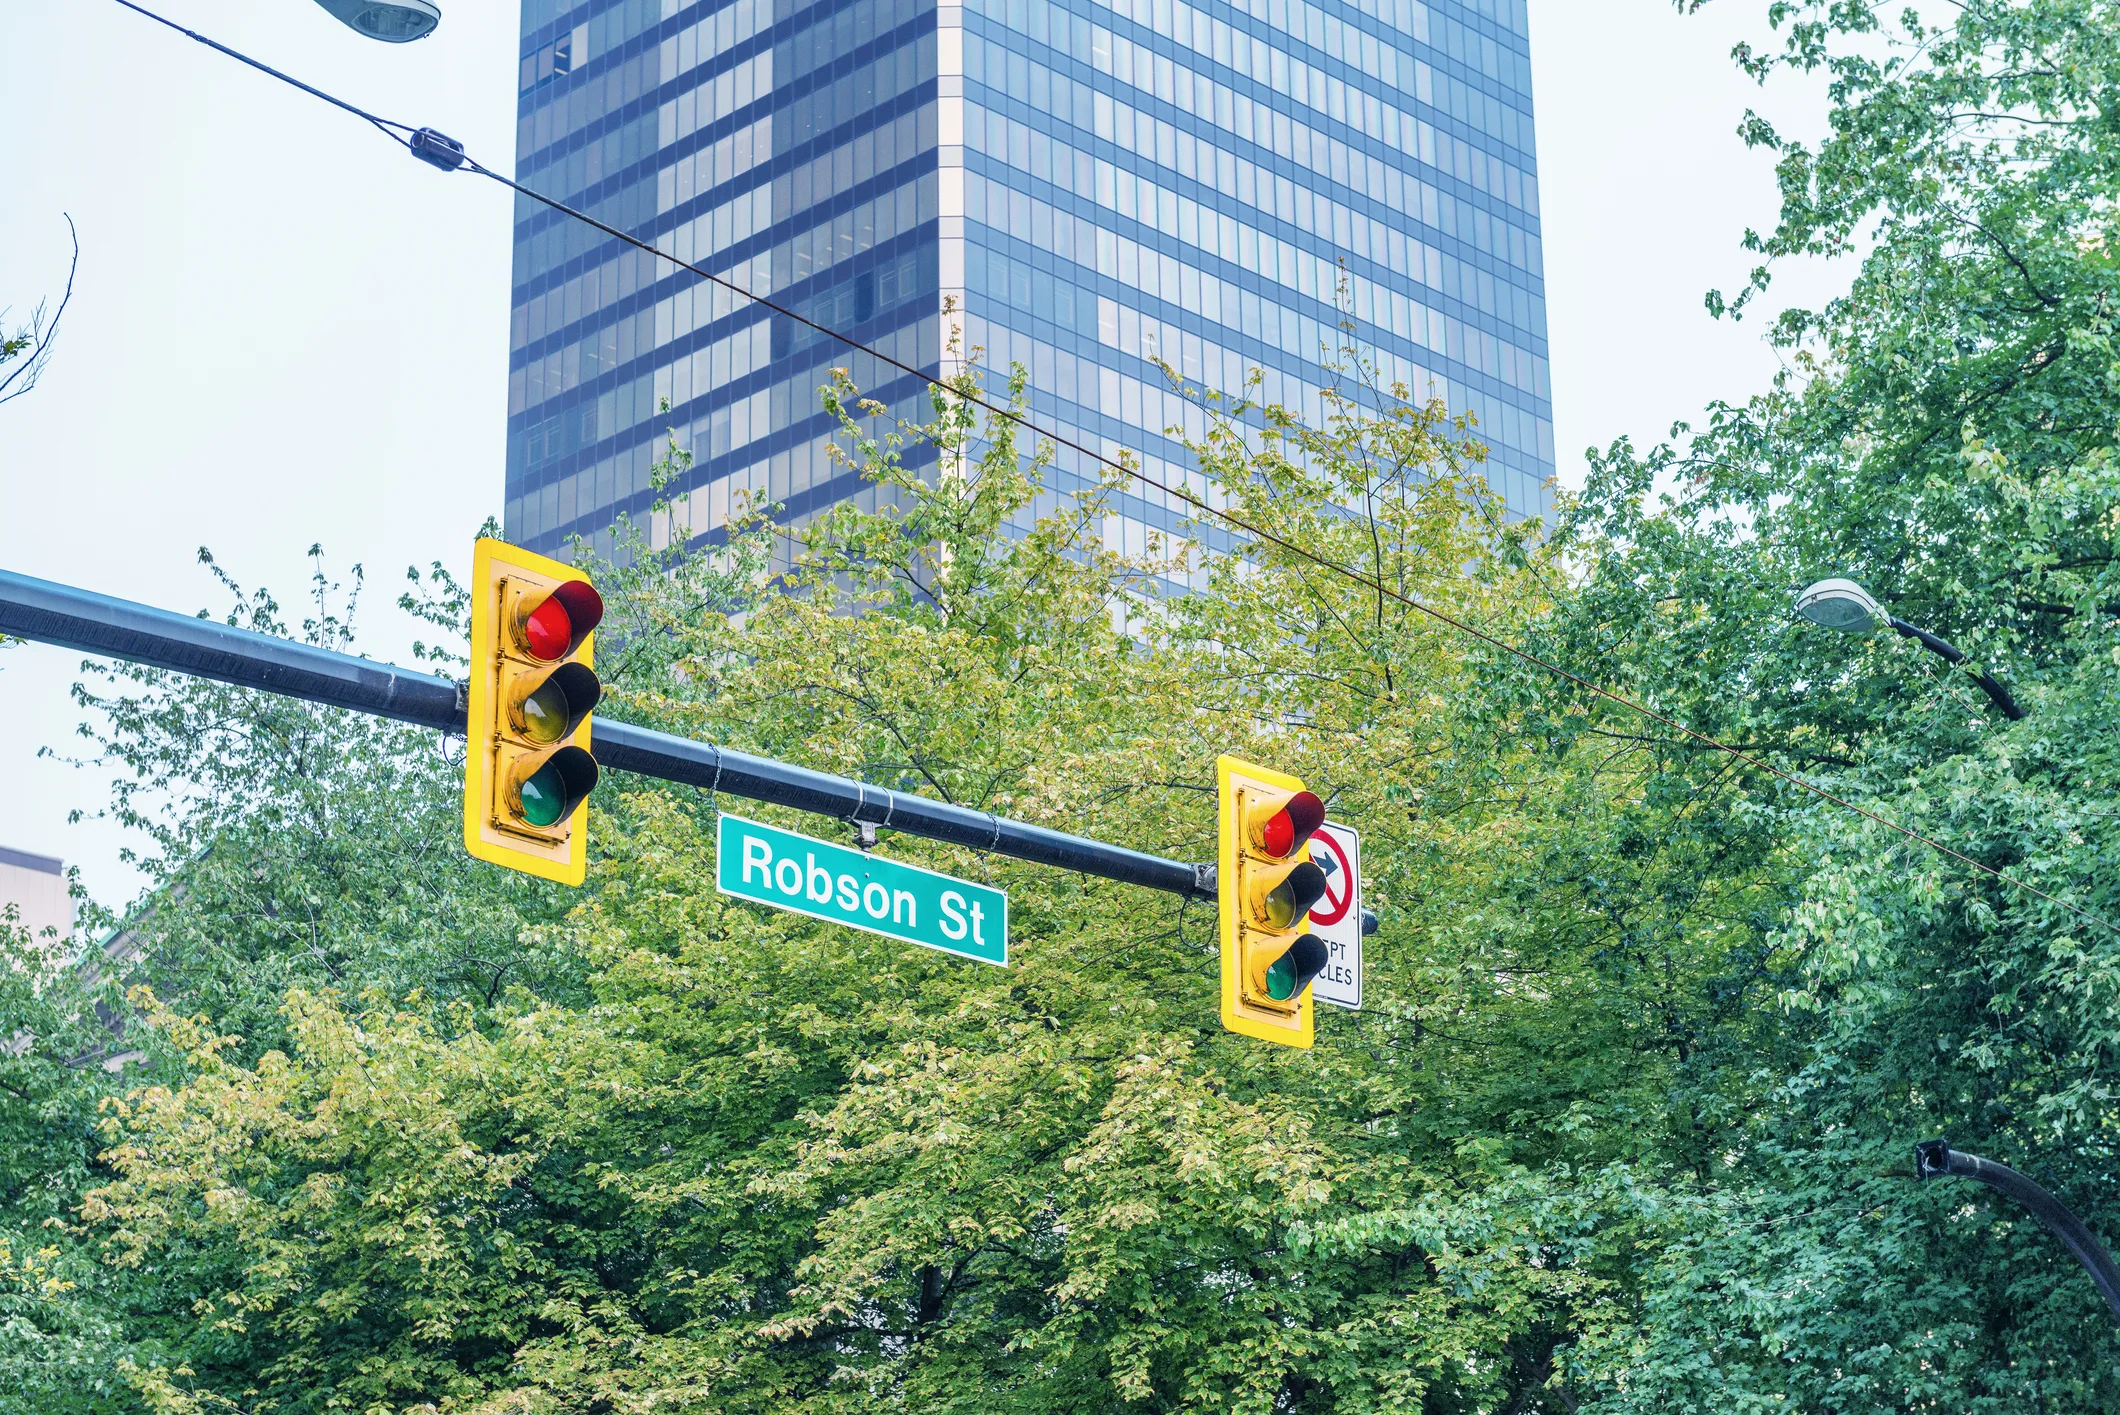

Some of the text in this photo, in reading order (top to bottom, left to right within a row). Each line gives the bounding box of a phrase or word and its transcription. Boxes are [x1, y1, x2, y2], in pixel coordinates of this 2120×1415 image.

[742, 835, 985, 945] Robson St
[1322, 938, 1346, 960] PT
